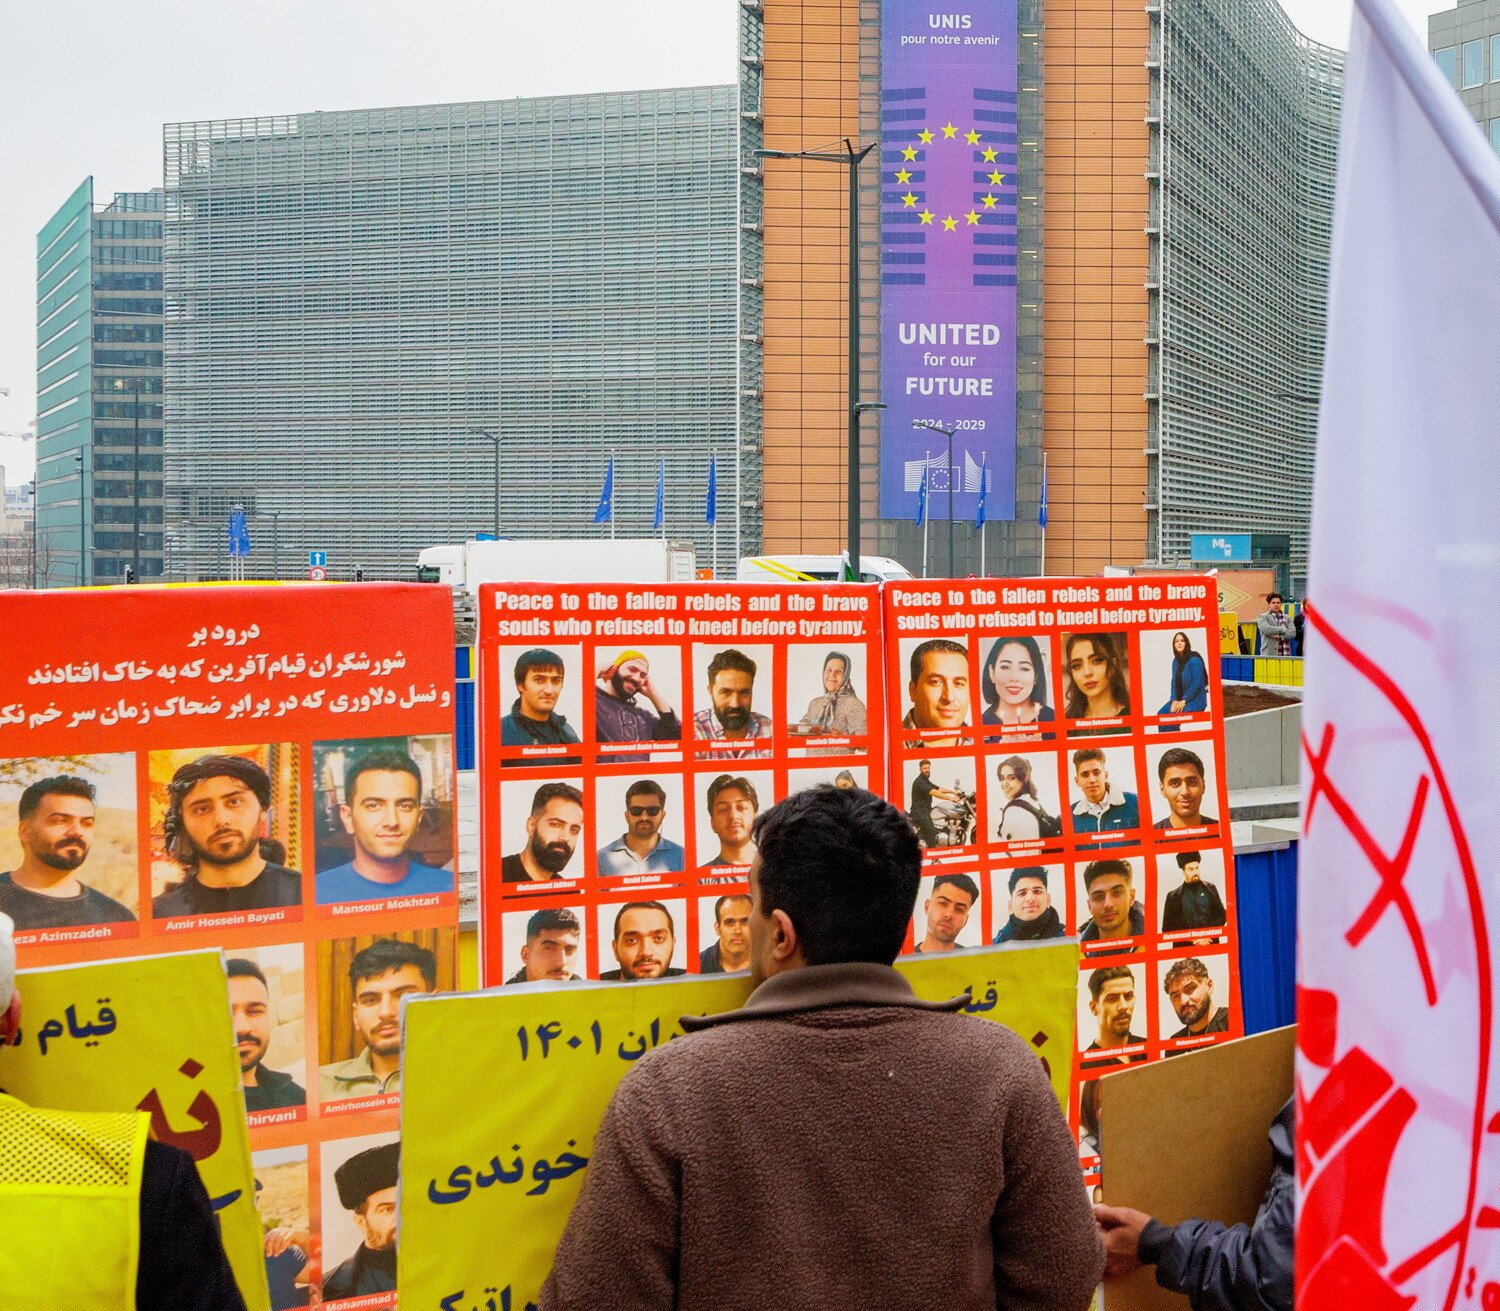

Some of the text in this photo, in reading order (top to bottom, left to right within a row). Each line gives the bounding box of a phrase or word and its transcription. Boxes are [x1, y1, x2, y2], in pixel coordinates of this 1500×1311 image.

[929, 14, 972, 29] UNIS
[901, 34, 1000, 46] pour notre avenir
[899, 323, 1000, 346] UNITED
[923, 352, 977, 367] for our
[906, 377, 993, 396] FUTURE
[912, 419, 944, 430] 2024
[955, 419, 986, 430] 2029
[495, 591, 868, 612] Peace to the fallen rebels and the brave
[892, 590, 941, 607] Peace
[948, 591, 965, 606] to
[970, 588, 996, 605] the
[1002, 587, 1046, 605] fallen
[1052, 585, 1100, 603] rebels
[1105, 585, 1133, 603] and
[1138, 584, 1162, 602] the
[1167, 583, 1206, 601] brave
[499, 617, 866, 638] souls who refused to kneel before tyranny.
[897, 606, 1205, 631] souls who refused to kneel before tyranny.
[187, 623, 261, 648] درود بر
[28, 660, 99, 685] افتادند
[102, 660, 154, 682] خاک
[156, 663, 177, 684] به
[179, 658, 206, 679] که
[308, 650, 406, 678] شورشگران
[154, 695, 222, 717] ضحاک
[225, 692, 271, 720] برابر
[274, 694, 298, 718] در
[301, 689, 326, 709] که
[329, 686, 397, 713] دلاوری
[400, 683, 437, 709] نسل
[439, 690, 451, 708] و
[29, 702, 63, 730] خم
[66, 708, 97, 729] سر
[100, 699, 150, 726] زمان
[332, 894, 440, 916] Mansour Mokhtari
[166, 910, 285, 932] Amir Hossein Bayati
[14, 927, 112, 945] eza Azimzadeh
[38, 997, 118, 1056] قیام
[517, 1018, 603, 1062] ۱۴۰۱
[324, 1098, 386, 1114] Amirhossein
[427, 1139, 589, 1205] خوندی
[326, 1294, 391, 1311] Mohammad
